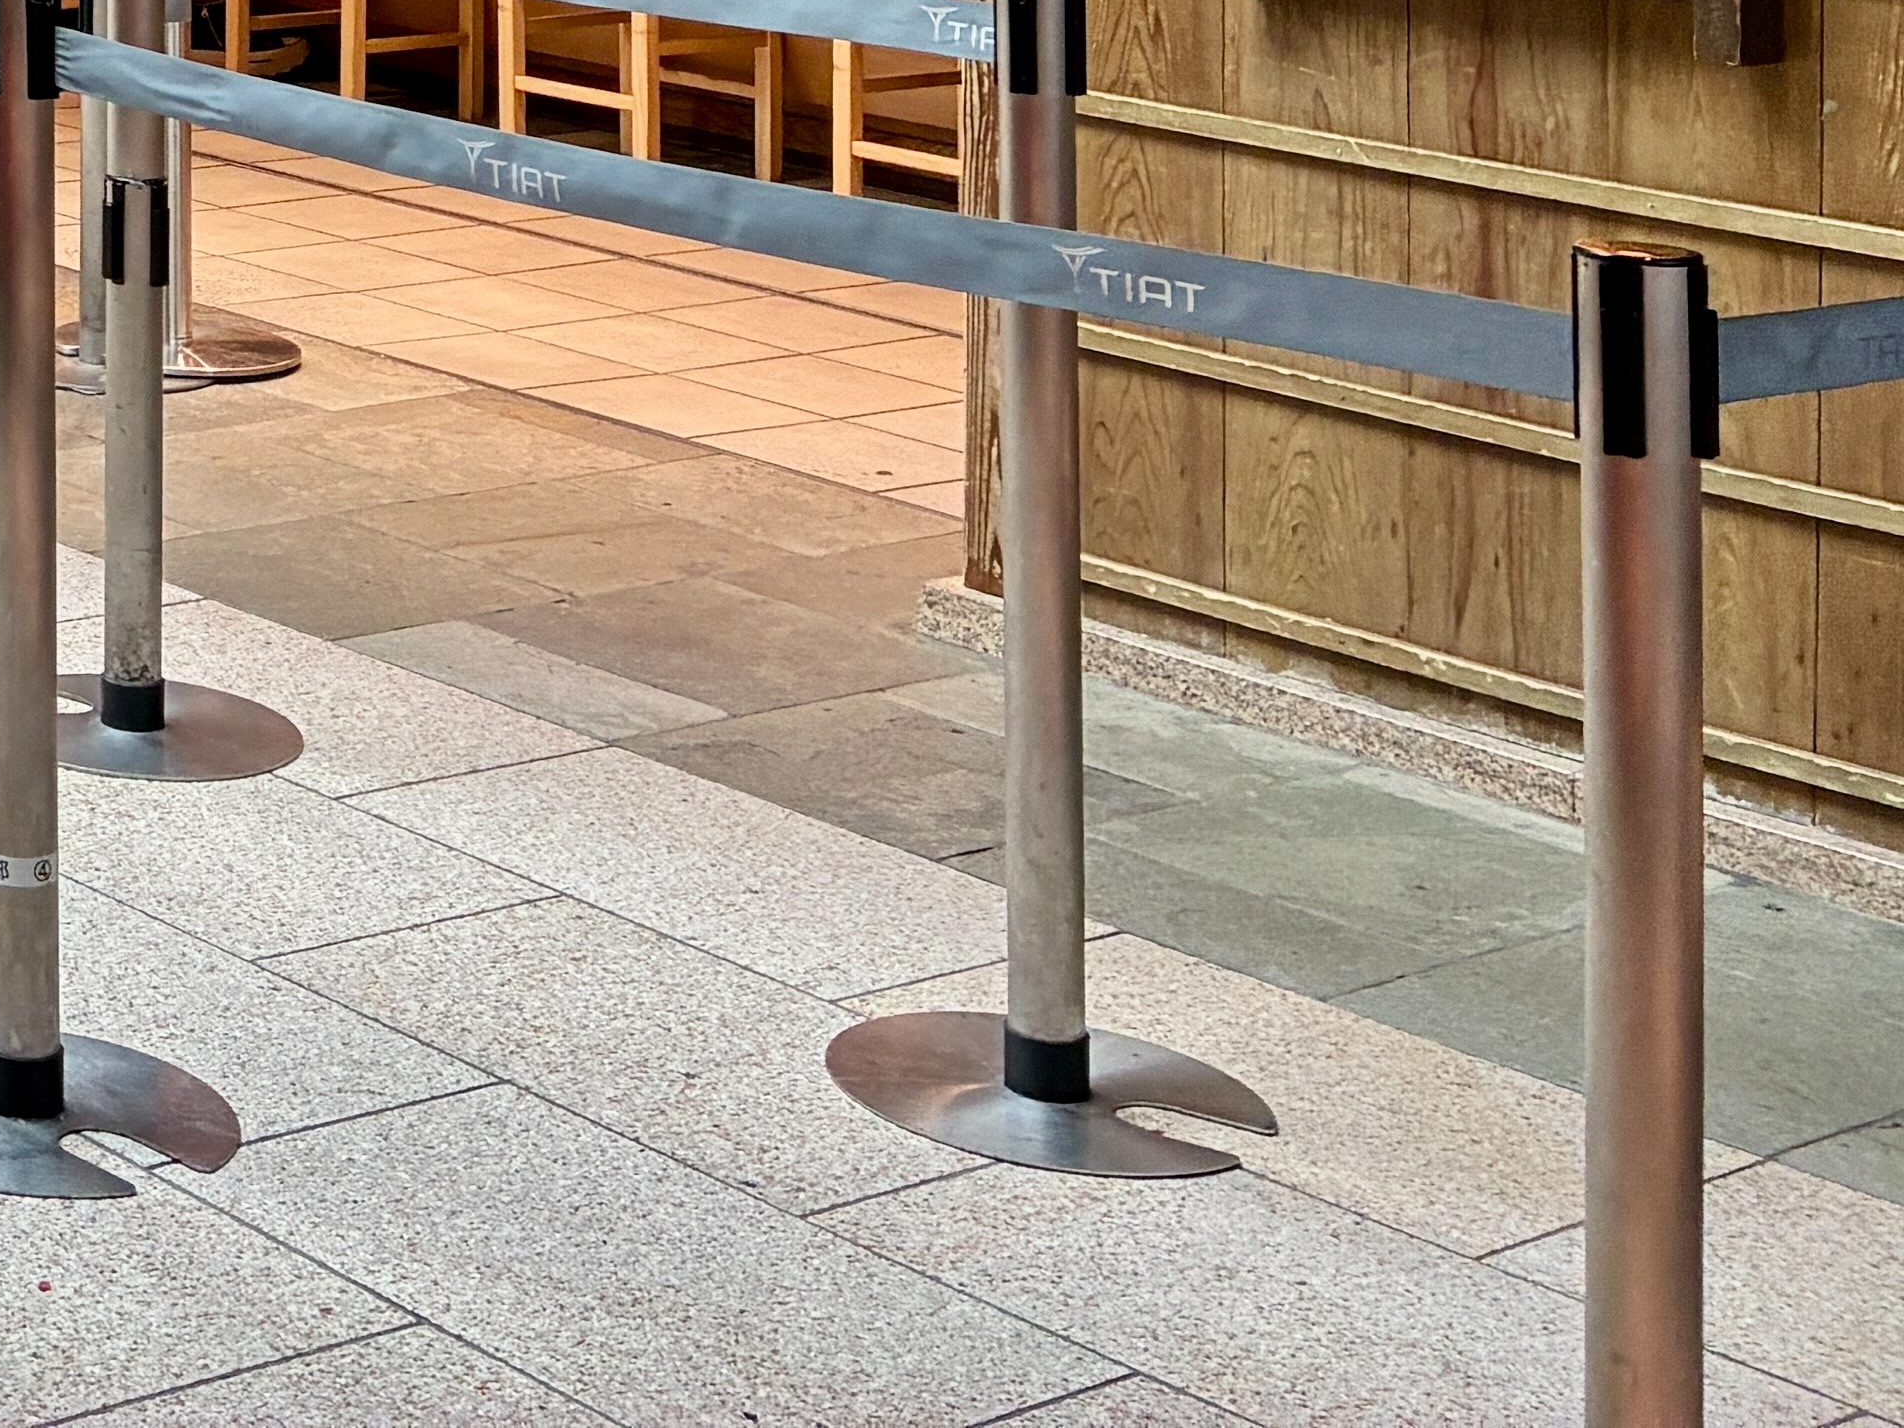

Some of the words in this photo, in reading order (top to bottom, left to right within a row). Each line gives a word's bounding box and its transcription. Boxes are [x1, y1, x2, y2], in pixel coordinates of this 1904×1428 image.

[947, 21, 995, 51] TIA
[483, 158, 568, 203] TIAT
[1089, 267, 1205, 313] TIAT
